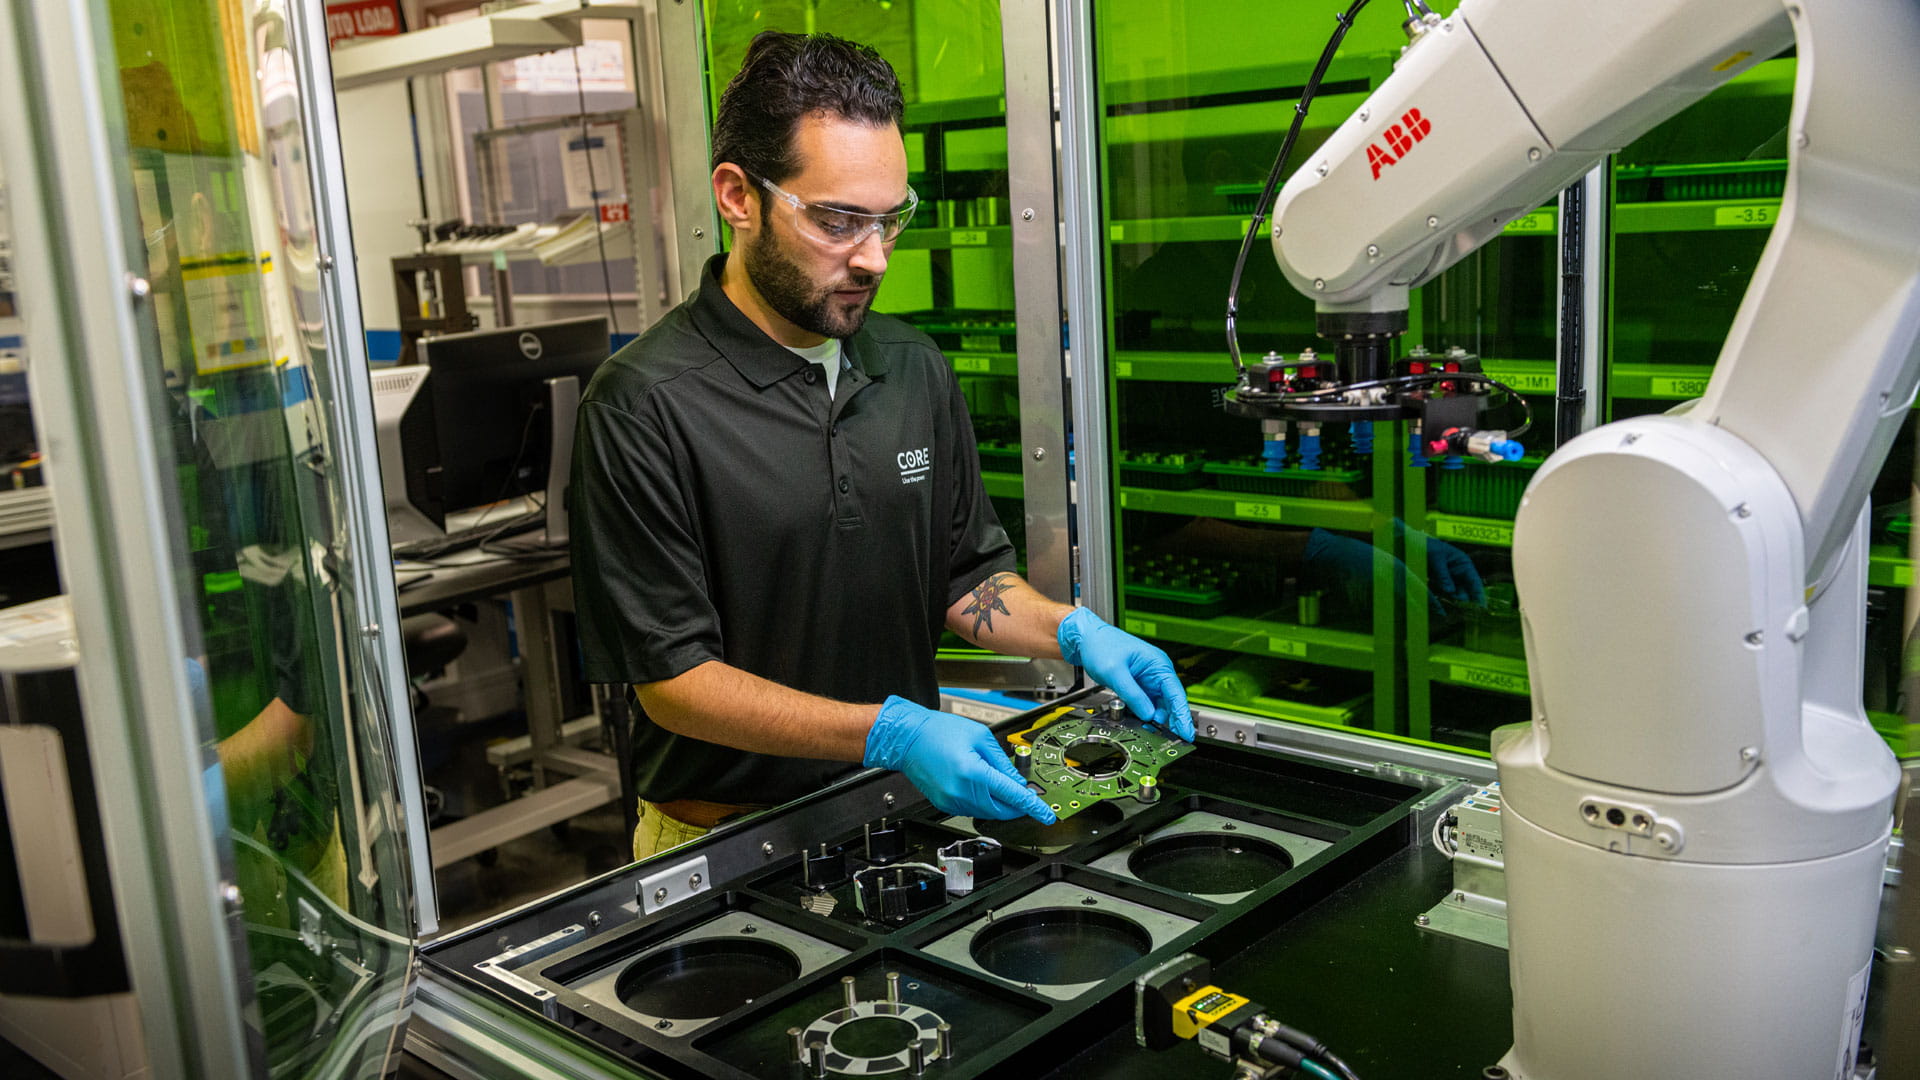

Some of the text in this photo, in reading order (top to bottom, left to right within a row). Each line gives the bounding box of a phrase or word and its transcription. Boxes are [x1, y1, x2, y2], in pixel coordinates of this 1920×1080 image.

[353, 5, 395, 33] LOAD
[1366, 107, 1431, 181] ABB
[1735, 208, 1767, 222] -3.5
[1671, 380, 1707, 394] 1380
[897, 447, 930, 470] CORE
